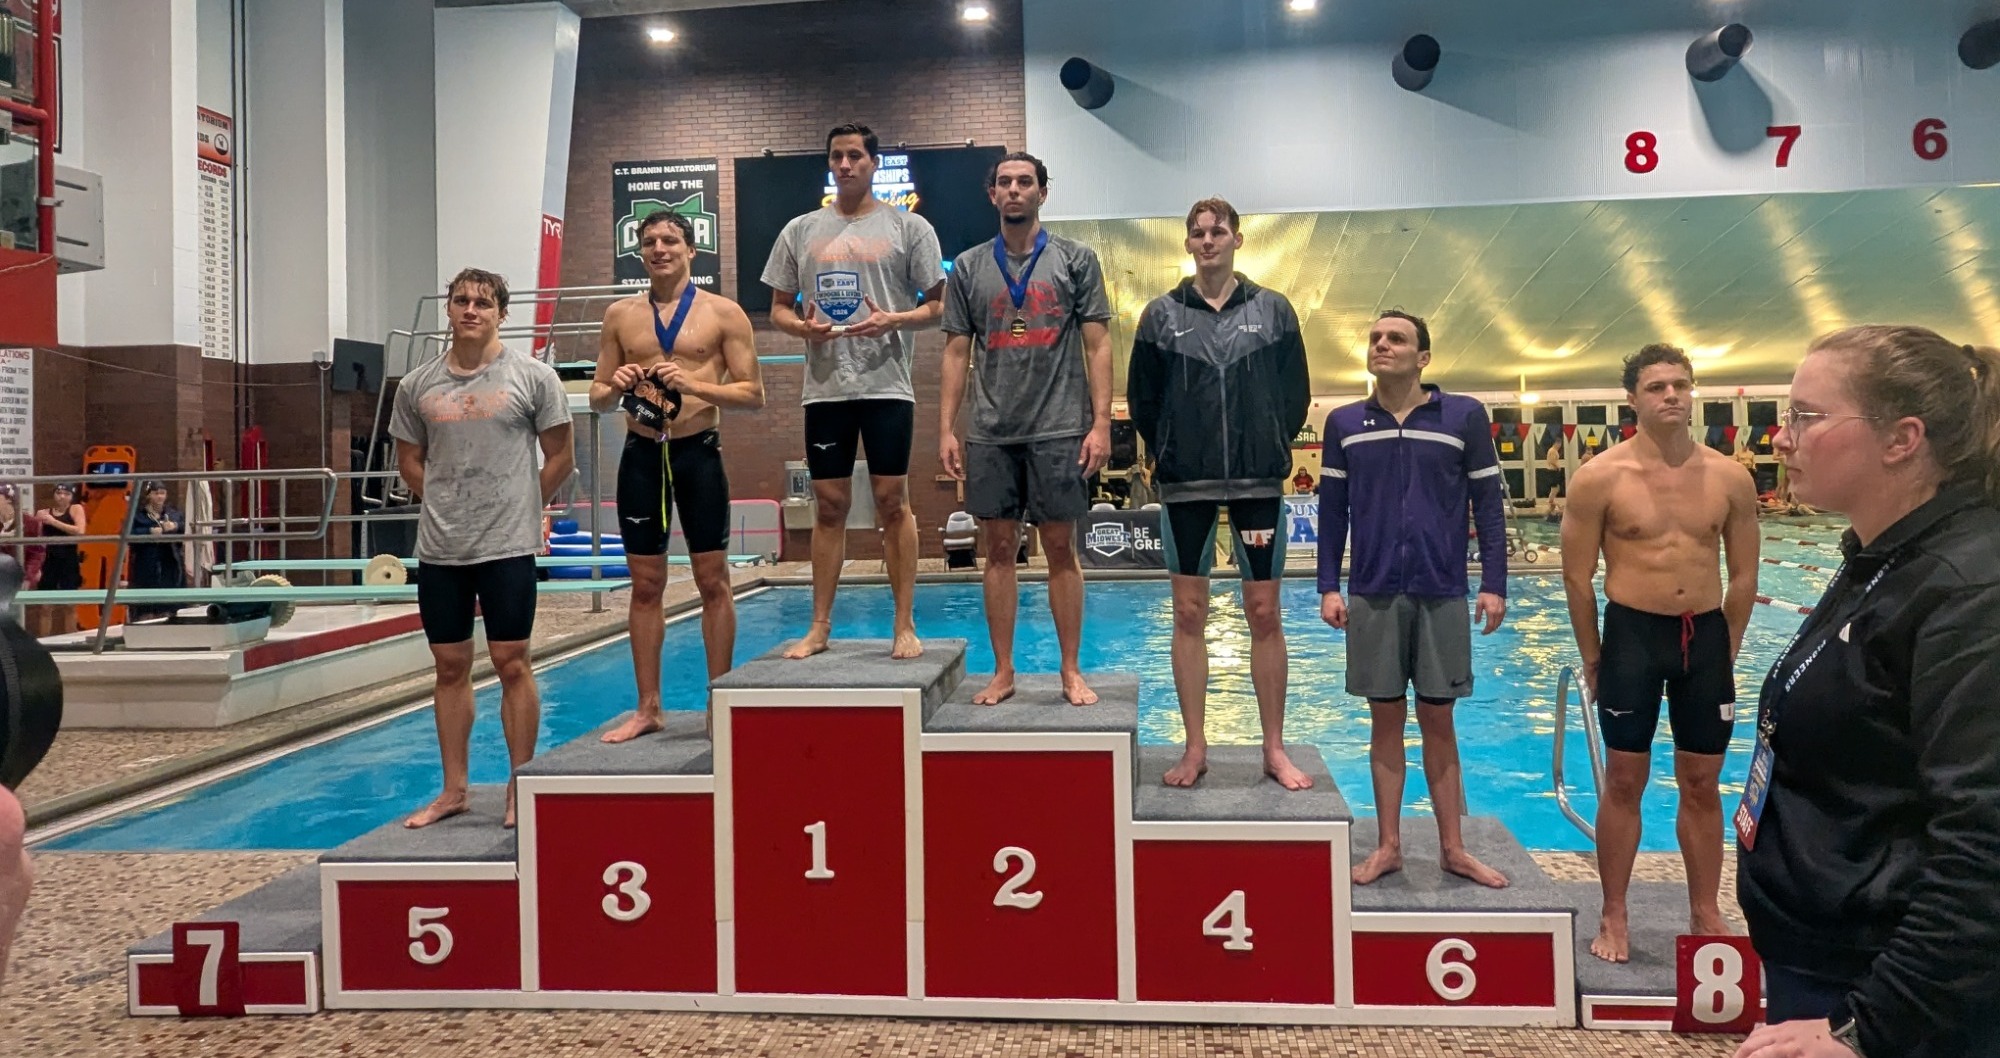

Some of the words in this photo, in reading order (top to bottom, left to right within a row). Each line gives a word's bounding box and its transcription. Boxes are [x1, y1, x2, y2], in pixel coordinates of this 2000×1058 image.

[631, 166, 662, 174] BRANIN
[664, 164, 717, 173] NATATORIUM
[1624, 131, 1659, 174] 8
[1766, 125, 1801, 168] 7
[1912, 118, 1948, 161] 6
[628, 182, 660, 191] HOME
[663, 181, 678, 190] OF
[680, 180, 704, 189] THE
[543, 218, 562, 239] TYR
[1086, 532, 1130, 543] MIDWEST
[1134, 527, 1149, 538] BE
[1134, 539, 1165, 550] GRE
[1241, 529, 1275, 547] UAF
[803, 821, 834, 879] 1
[993, 846, 1043, 909] 2
[602, 861, 651, 921] 3
[408, 906, 453, 965] 5
[1202, 890, 1253, 950] 4
[186, 930, 225, 1005] 7
[1426, 938, 1477, 1000] 6
[1691, 942, 1745, 1024] 8
